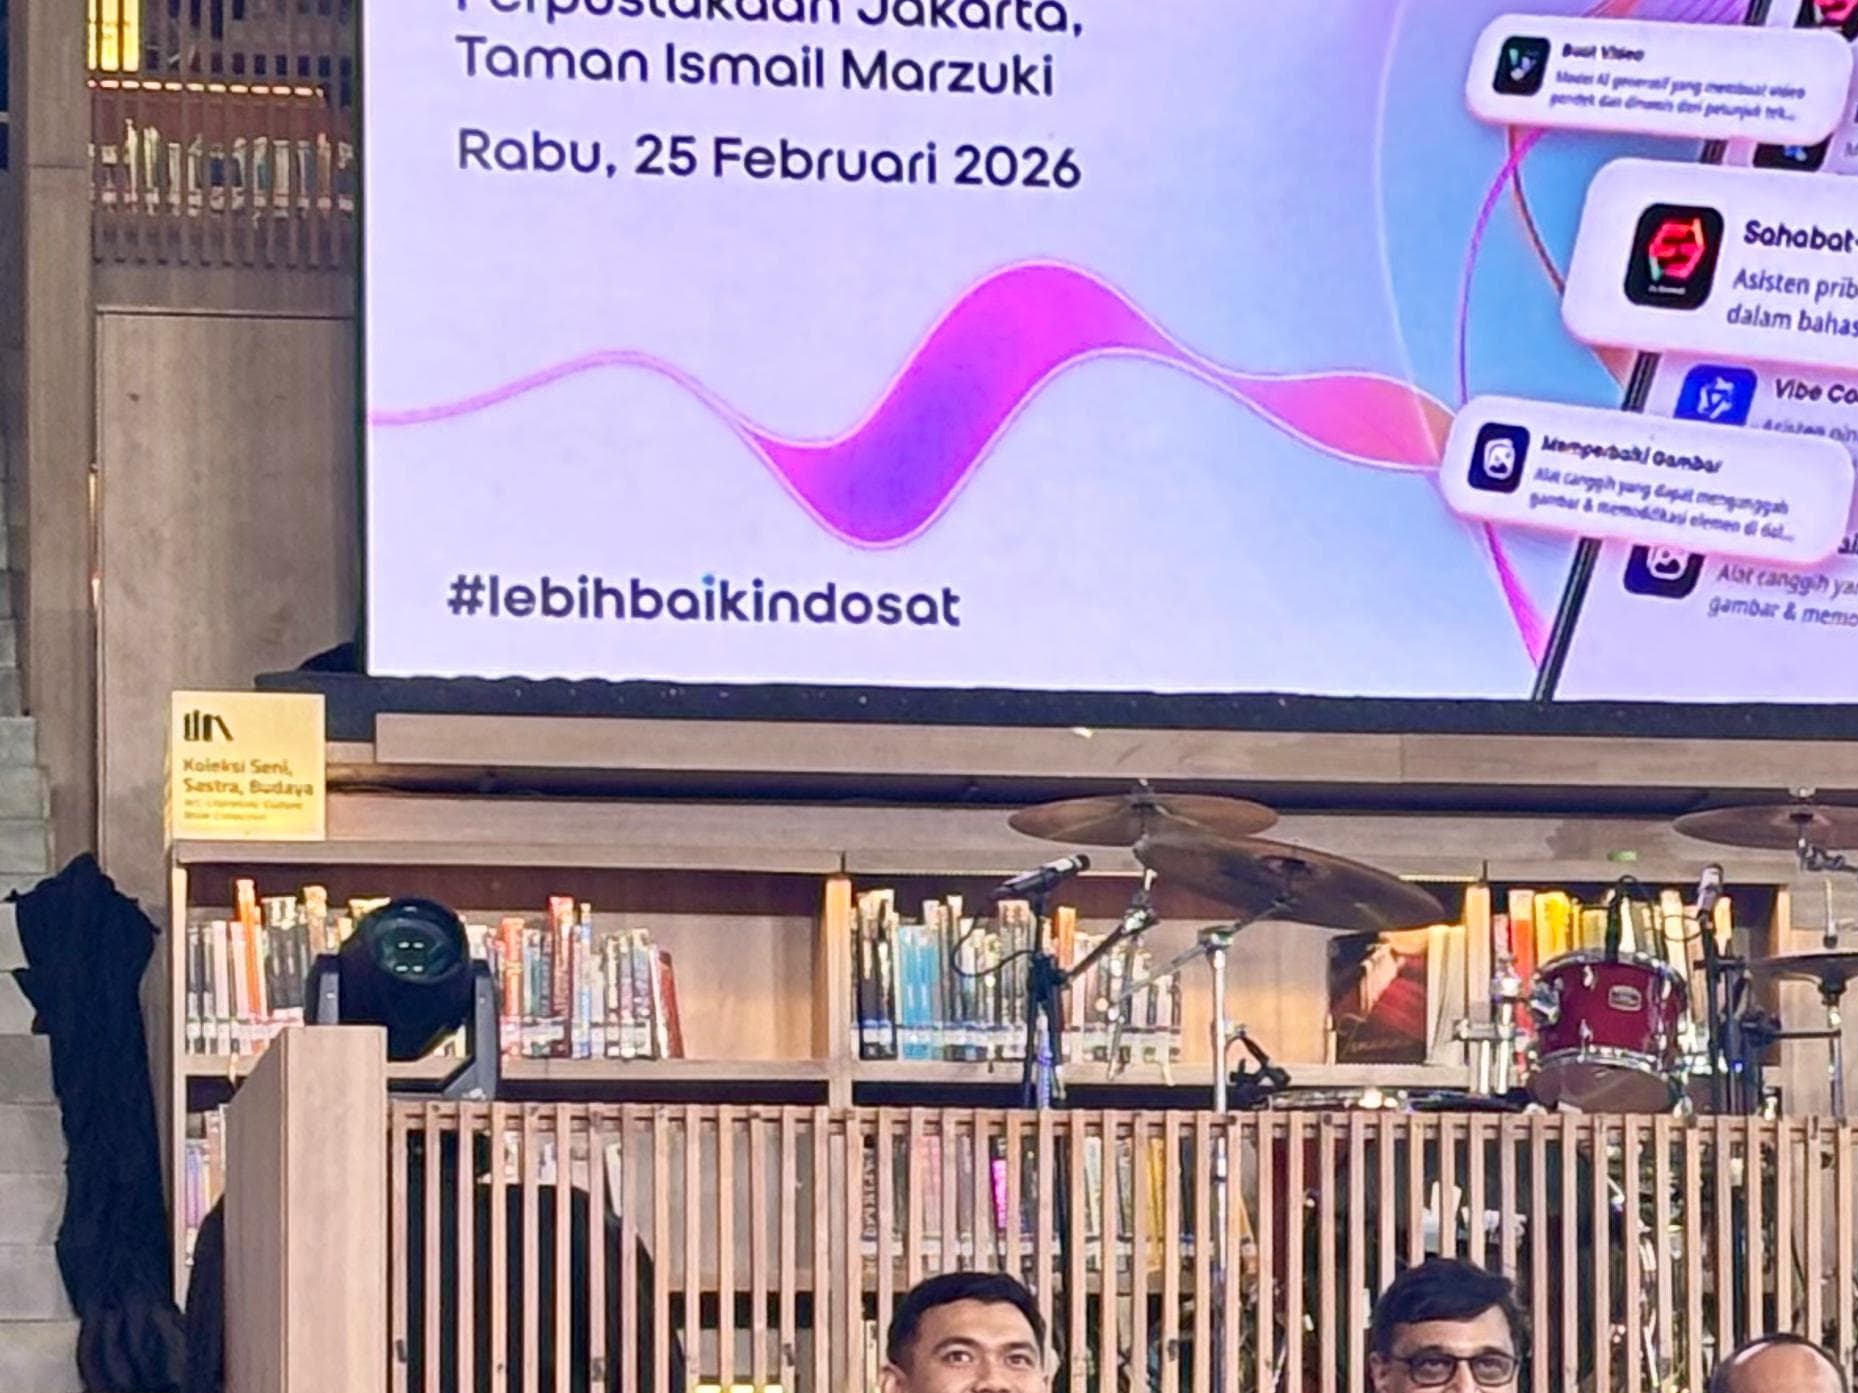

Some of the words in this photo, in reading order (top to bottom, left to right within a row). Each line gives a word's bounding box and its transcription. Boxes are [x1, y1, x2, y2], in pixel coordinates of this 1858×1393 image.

[857, 0, 1083, 38] Jakarta,
[455, 34, 649, 82] Taman
[666, 42, 824, 88] Ismail
[842, 45, 1053, 96] Marzuki
[459, 127, 617, 179] Rabu,
[635, 133, 697, 177] 25
[713, 136, 937, 184] Februari
[954, 144, 1082, 189] 2026
[1732, 267, 1811, 296] Asisten
[1726, 303, 1793, 331] dalam
[1775, 377, 1823, 402] Vibe
[1715, 563, 1754, 584] Alat
[1756, 569, 1830, 598] canggih
[447, 573, 962, 628] #lebihbaikindosat
[1707, 595, 1780, 618] gambar
